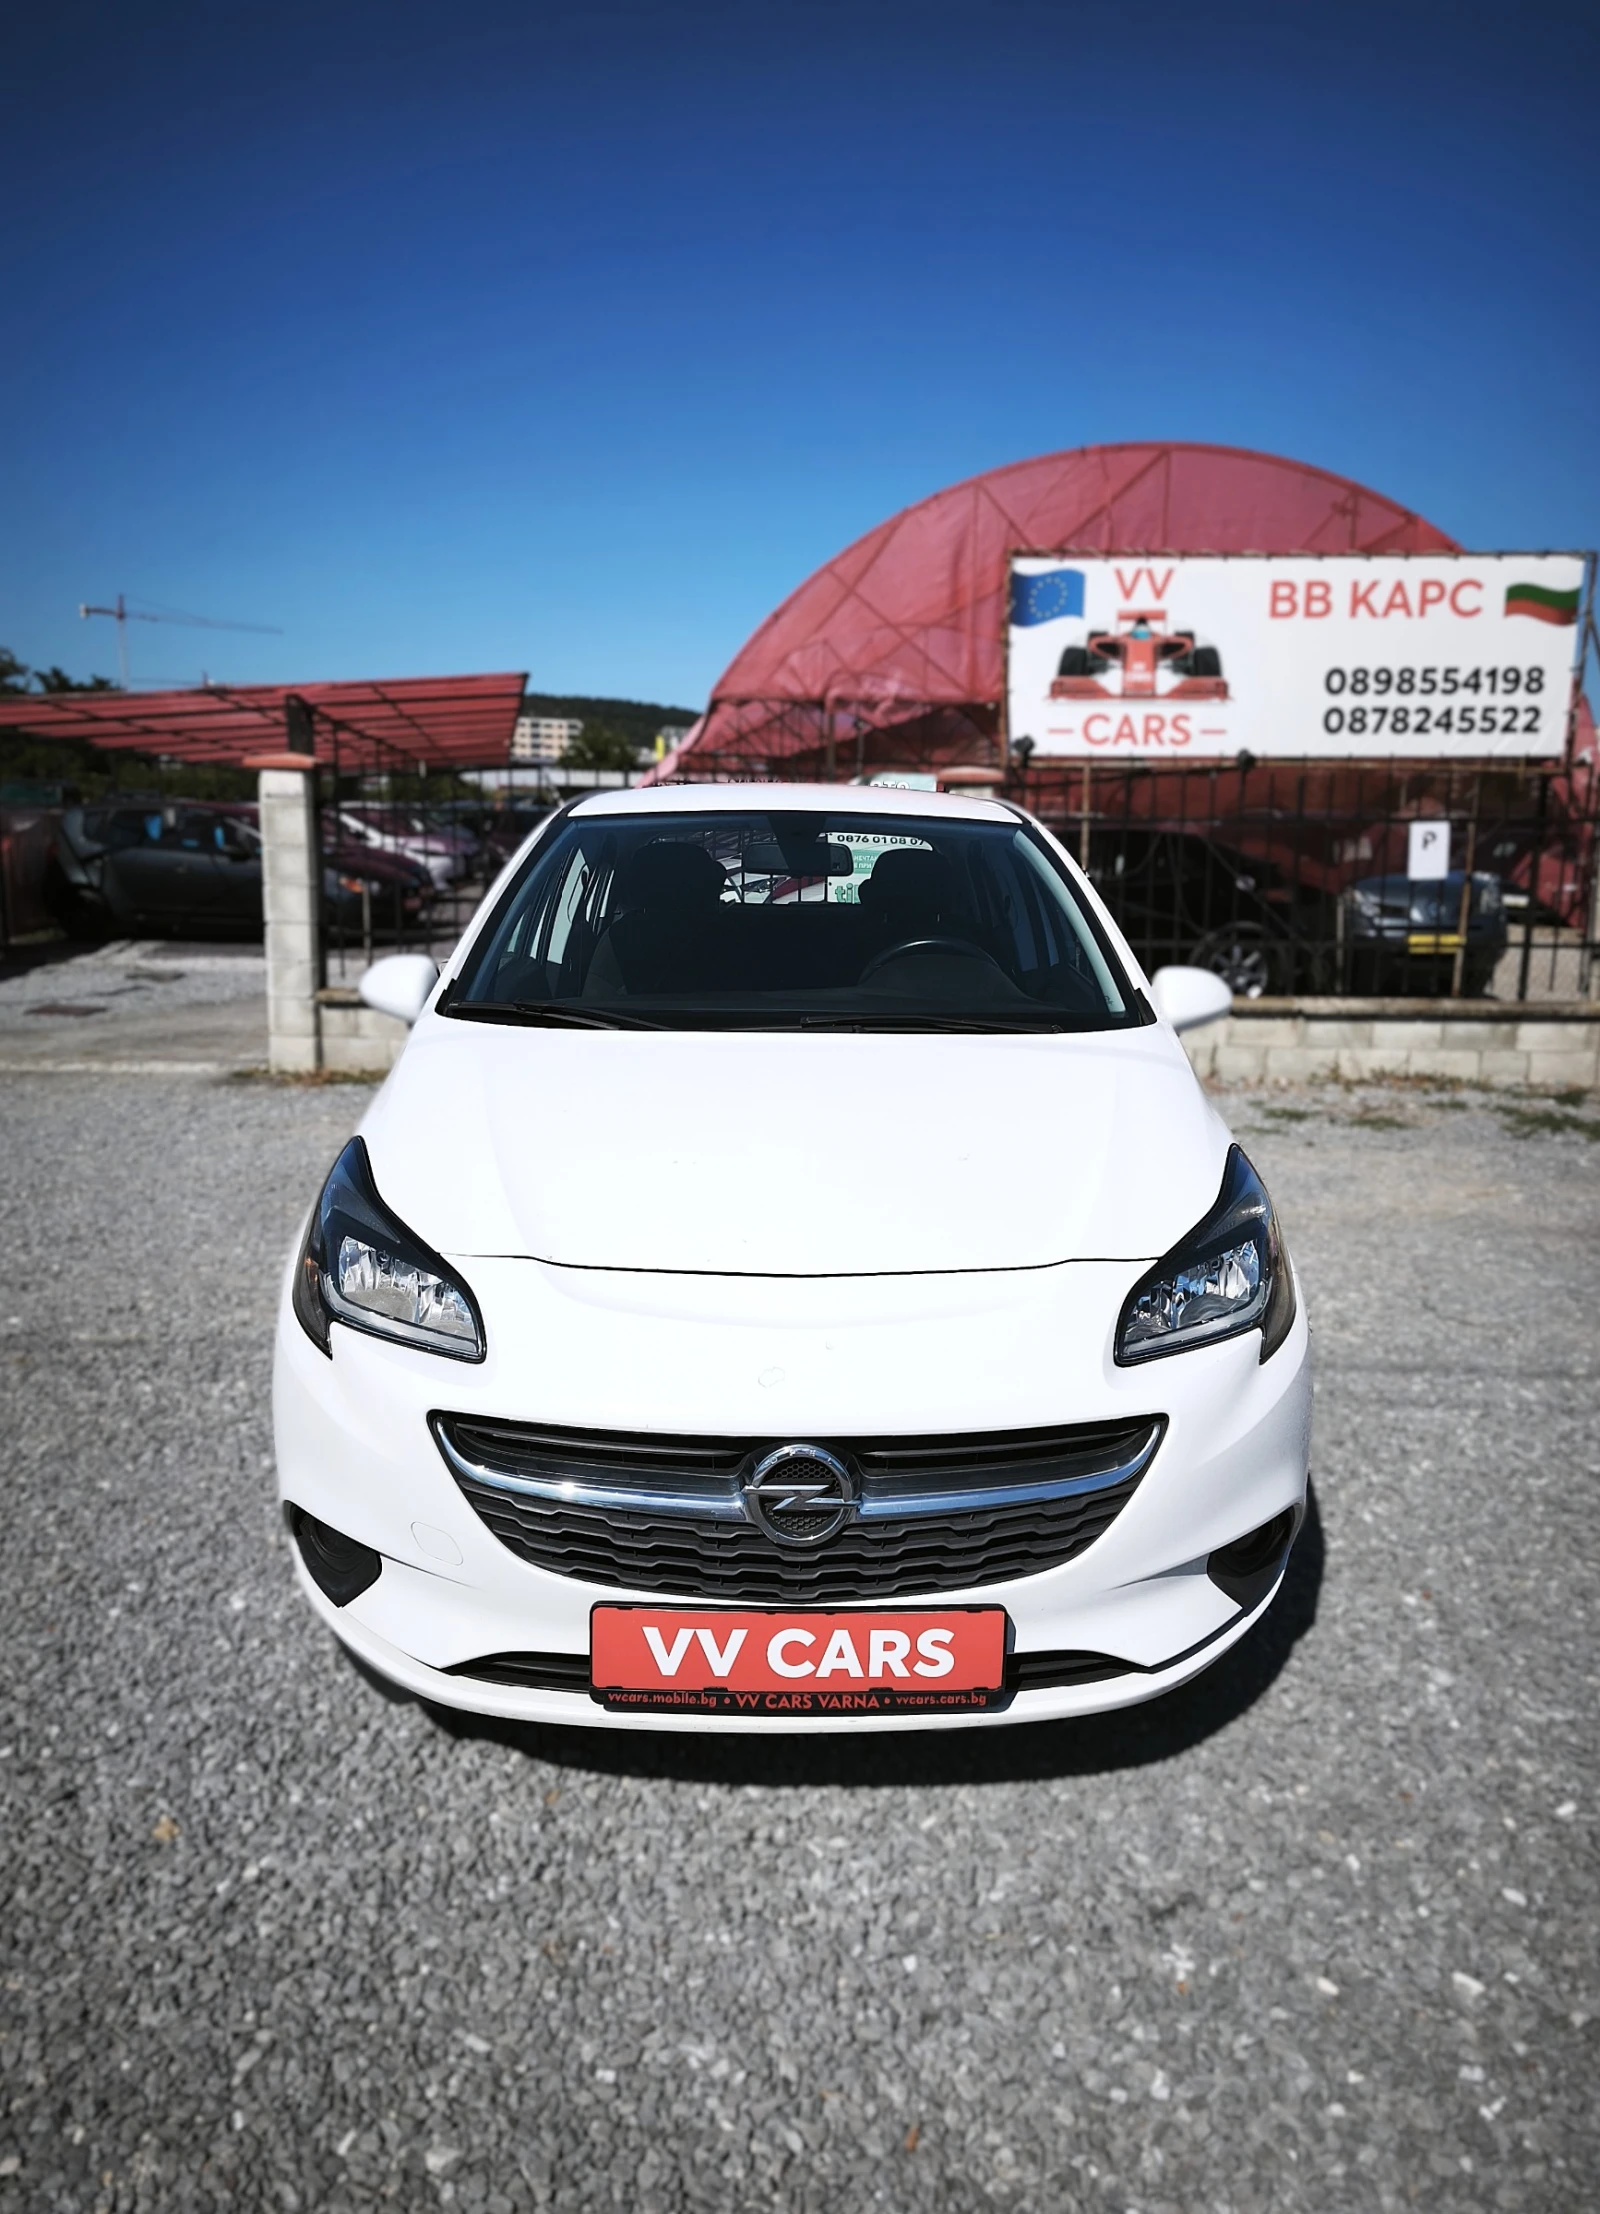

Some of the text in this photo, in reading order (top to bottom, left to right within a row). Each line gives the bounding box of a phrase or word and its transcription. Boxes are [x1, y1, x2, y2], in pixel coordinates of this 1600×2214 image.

[1115, 568, 1174, 601] VV
[1269, 579, 1484, 619] ВВ КАРС
[1325, 667, 1545, 695] 0898554198
[1081, 714, 1192, 747] CARS
[1323, 706, 1542, 734] 0878245522
[837, 834, 869, 843] 0876
[872, 836, 887, 844] 01
[890, 836, 906, 845] 08
[642, 1626, 955, 1678] VV CARS
[608, 1691, 987, 1709] vvcars.mobile.bg VV CARS VARNA vvcars.cars.bg
